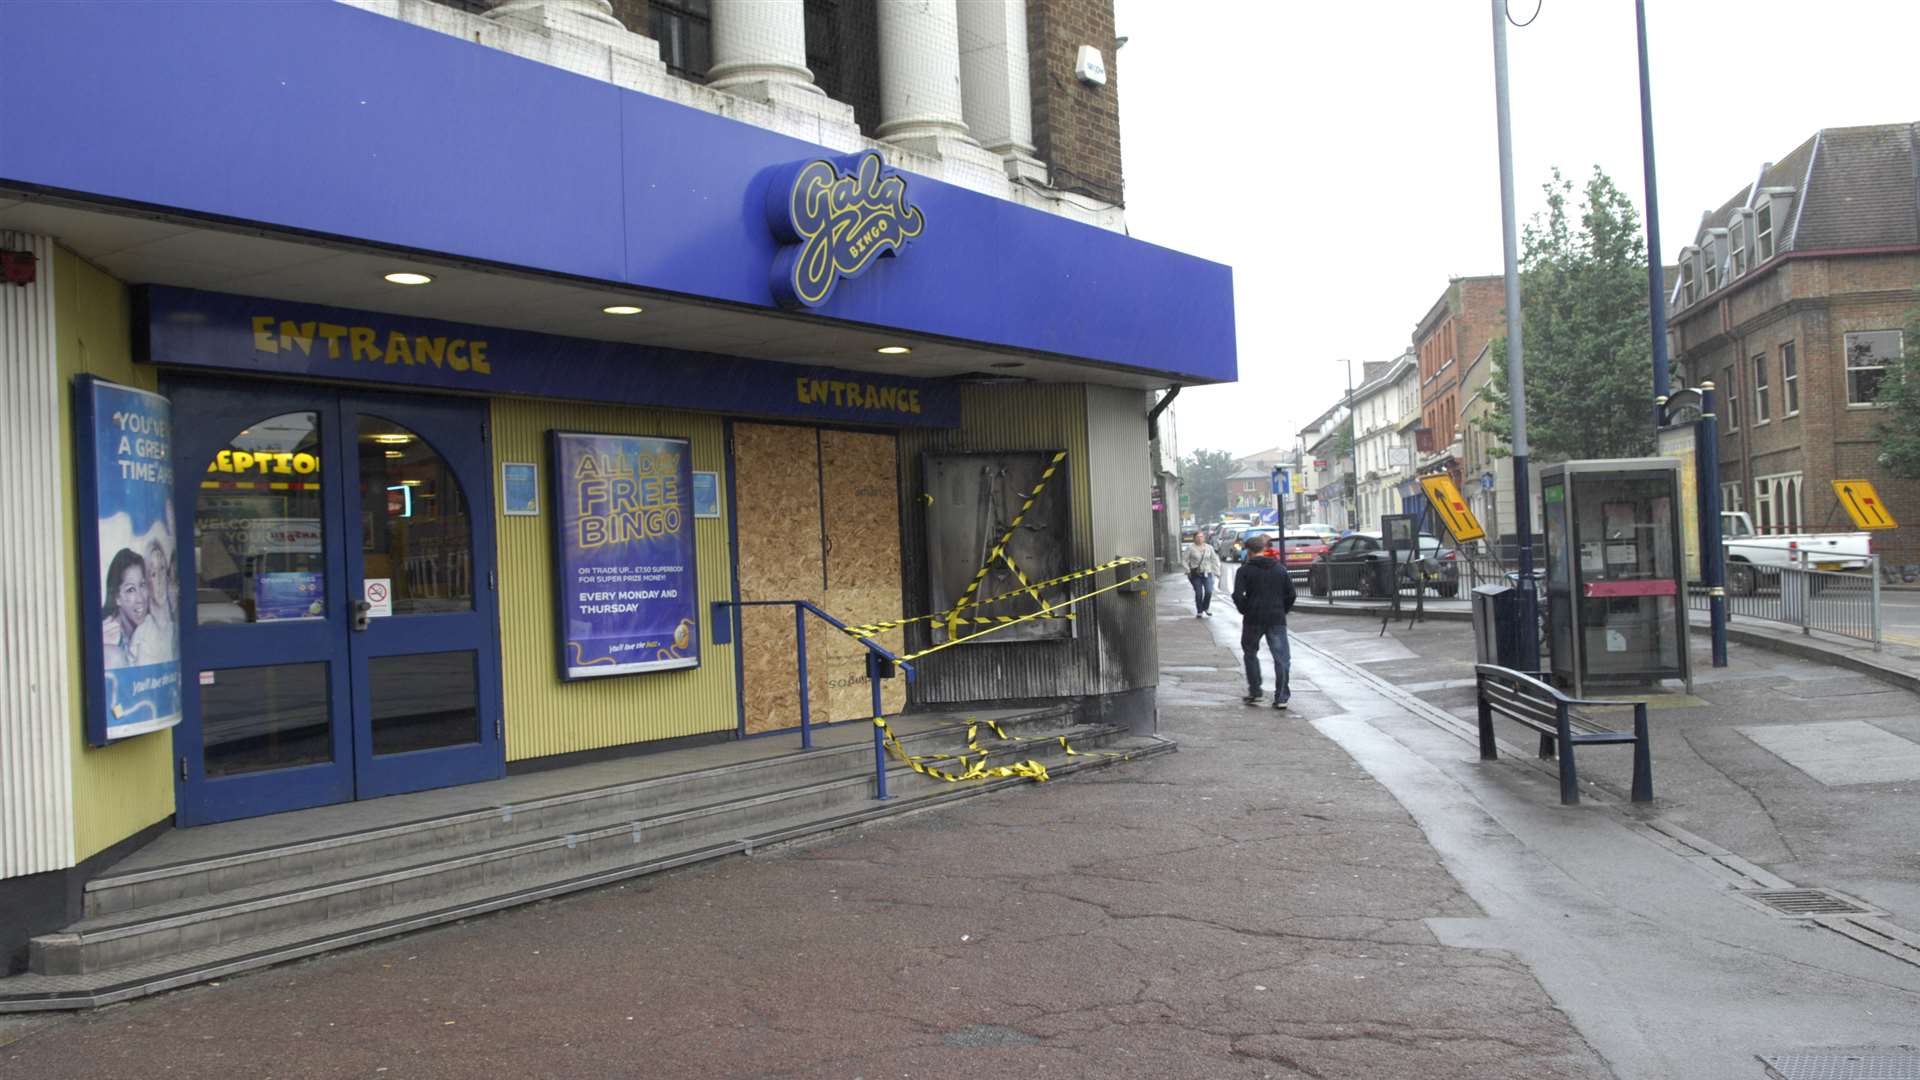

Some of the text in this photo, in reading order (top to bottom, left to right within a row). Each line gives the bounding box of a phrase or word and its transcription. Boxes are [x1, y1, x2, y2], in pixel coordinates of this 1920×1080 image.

[793, 154, 924, 301] Gala
[849, 218, 888, 258] BINGO
[252, 315, 492, 375] ENTRANCE
[796, 377, 921, 414] ENTRANCE
[118, 435, 131, 456] A
[207, 450, 320, 474] EPTIO
[575, 454, 633, 479] ALL
[578, 475, 680, 516] FREE
[578, 508, 681, 548] BINGO
[578, 567, 590, 575] OR
[596, 575, 622, 583] SUPER
[579, 589, 678, 602] EVERY MONDAY AND
[579, 603, 639, 614] THURSDAY
